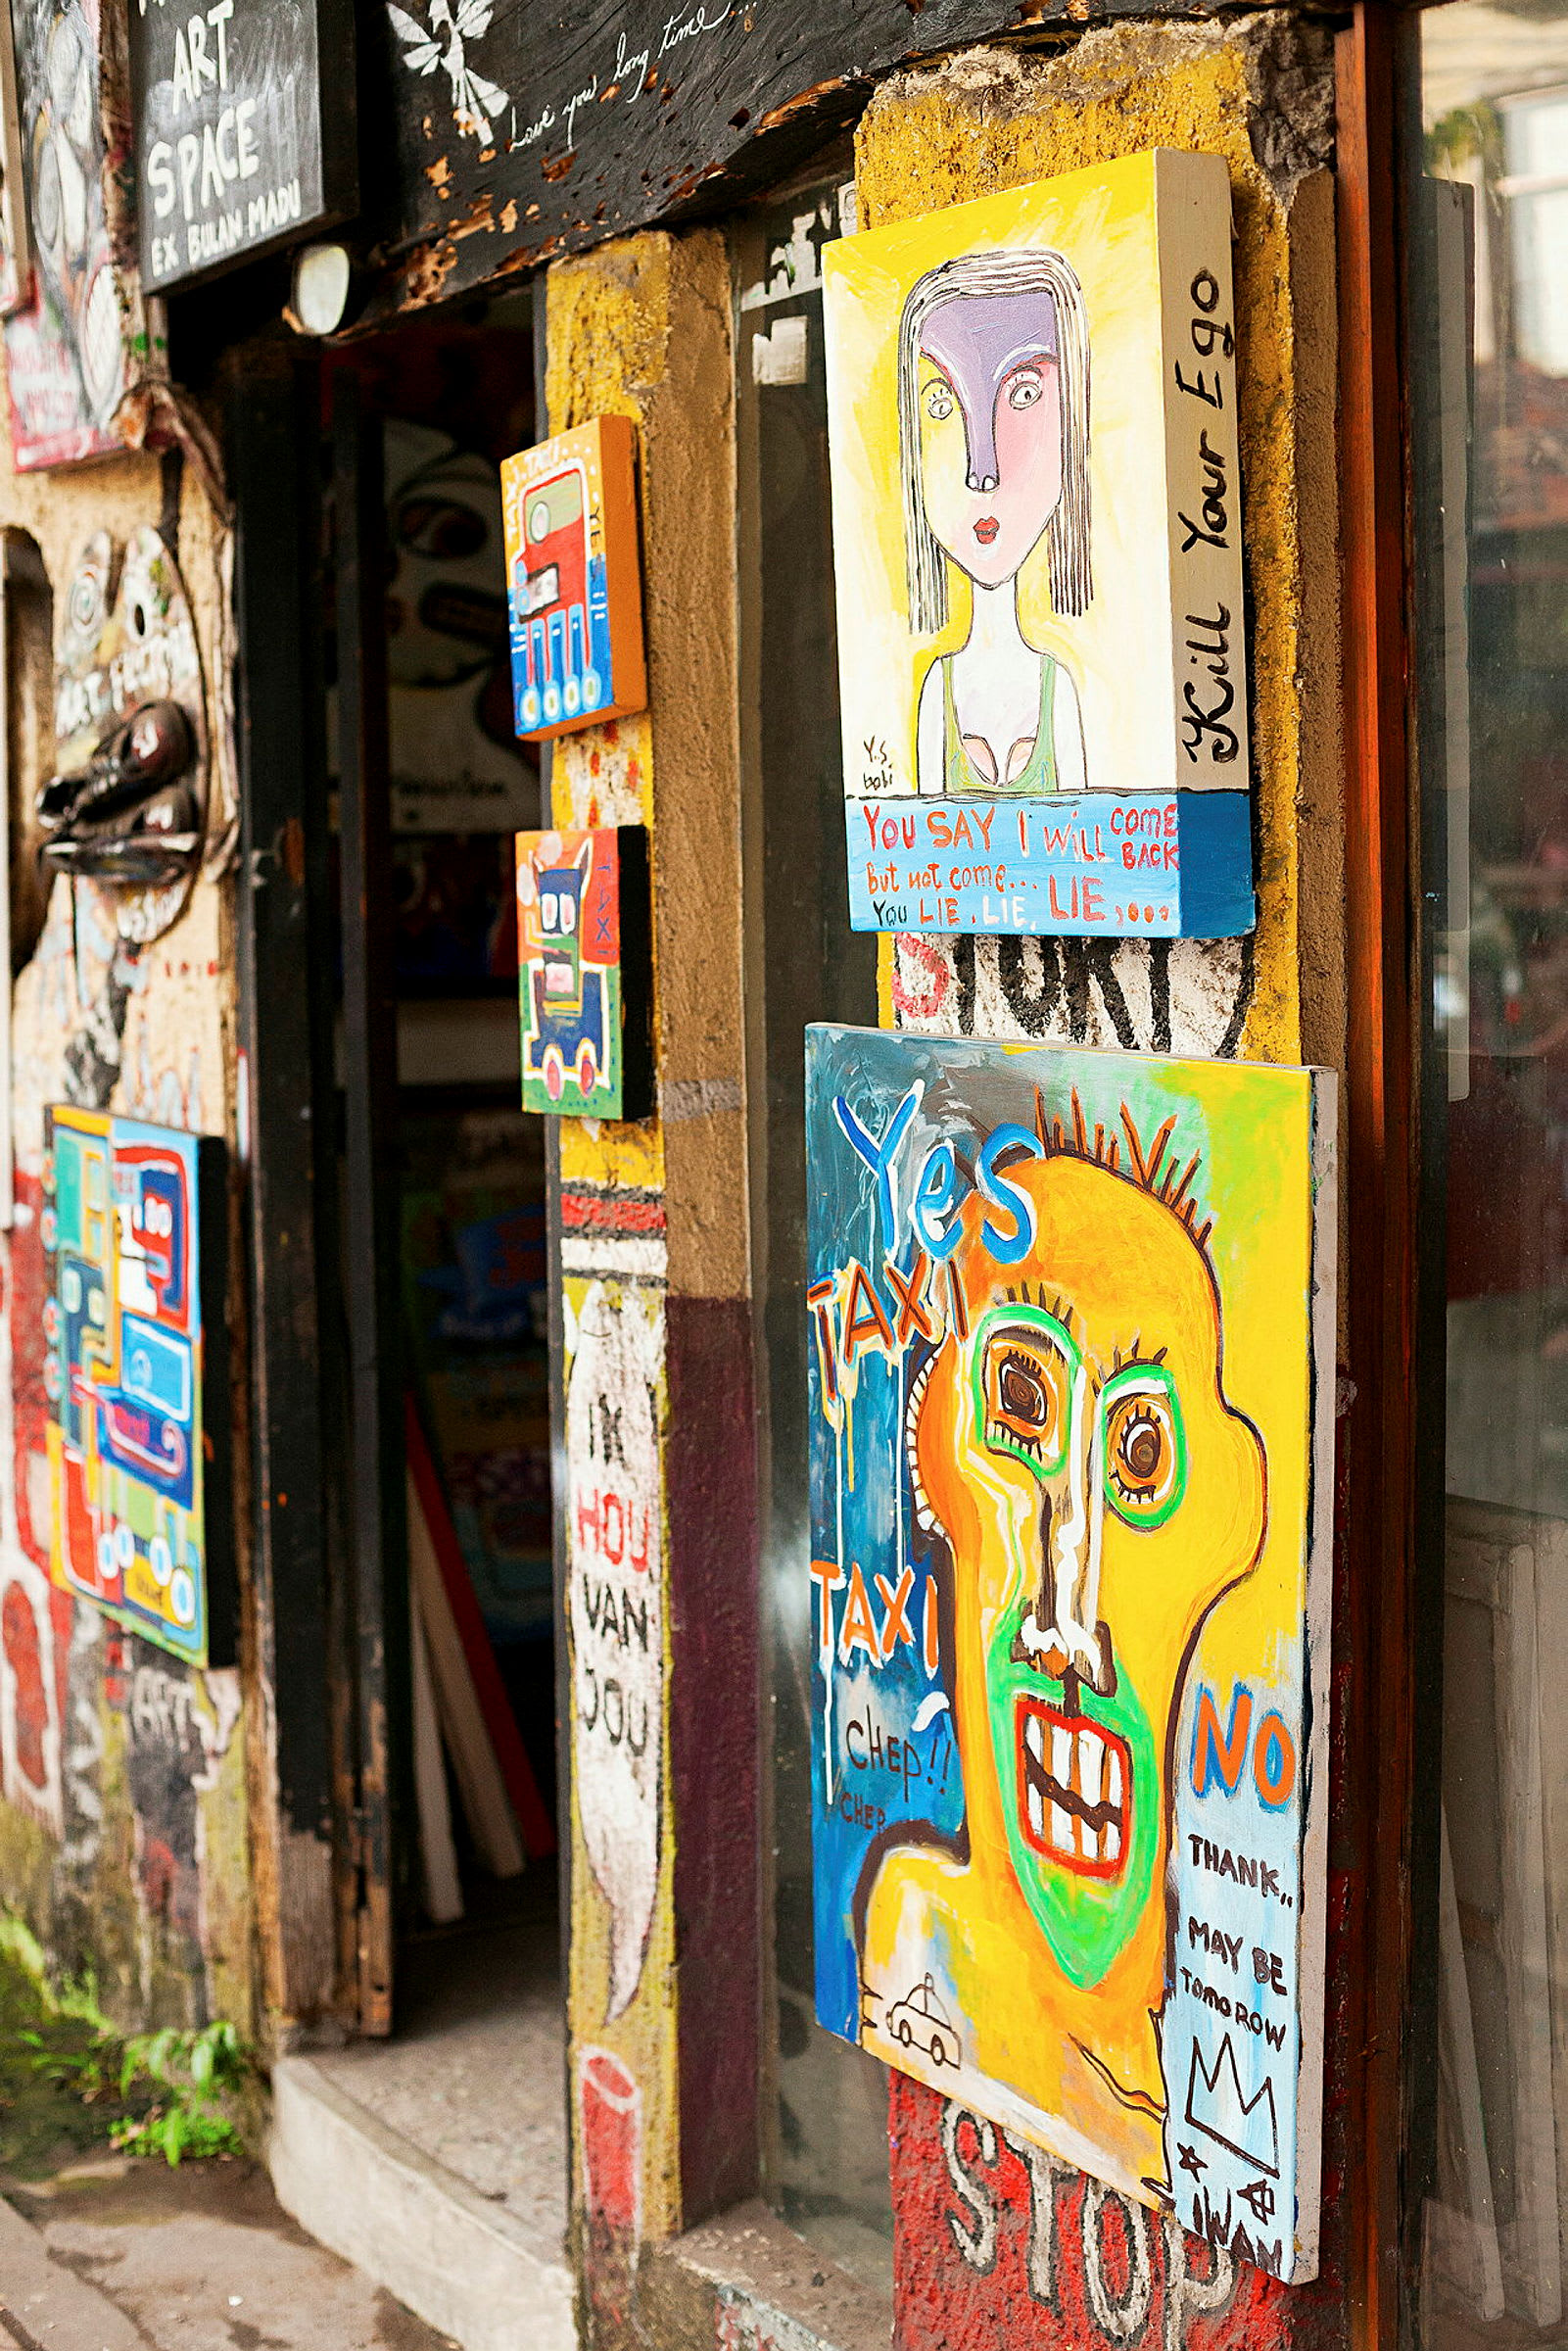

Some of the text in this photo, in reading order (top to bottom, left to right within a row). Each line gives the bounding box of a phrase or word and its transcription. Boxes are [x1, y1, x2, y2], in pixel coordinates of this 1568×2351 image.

[172, 0, 234, 115] ART
[561, 74, 597, 152] you
[612, 32, 649, 104] long
[147, 98, 260, 221] SPACE
[152, 232, 180, 277] EX
[248, 177, 302, 238] MADU
[1175, 267, 1234, 410] Ego
[1178, 428, 1231, 553] Your
[866, 861, 900, 895] But
[907, 862, 943, 890] not
[927, 805, 995, 852] SAY
[1017, 808, 1030, 858] I
[1121, 840, 1180, 870] BACK
[806, 1249, 969, 1403] TAXI
[578, 1485, 649, 1572] HOU
[583, 1573, 648, 1654] VAN
[809, 1559, 939, 1681] TAXI
[1190, 1681, 1296, 1813] NO
[1188, 1915, 1289, 1997] MAY BE
[940, 2096, 1238, 2351] STOP
